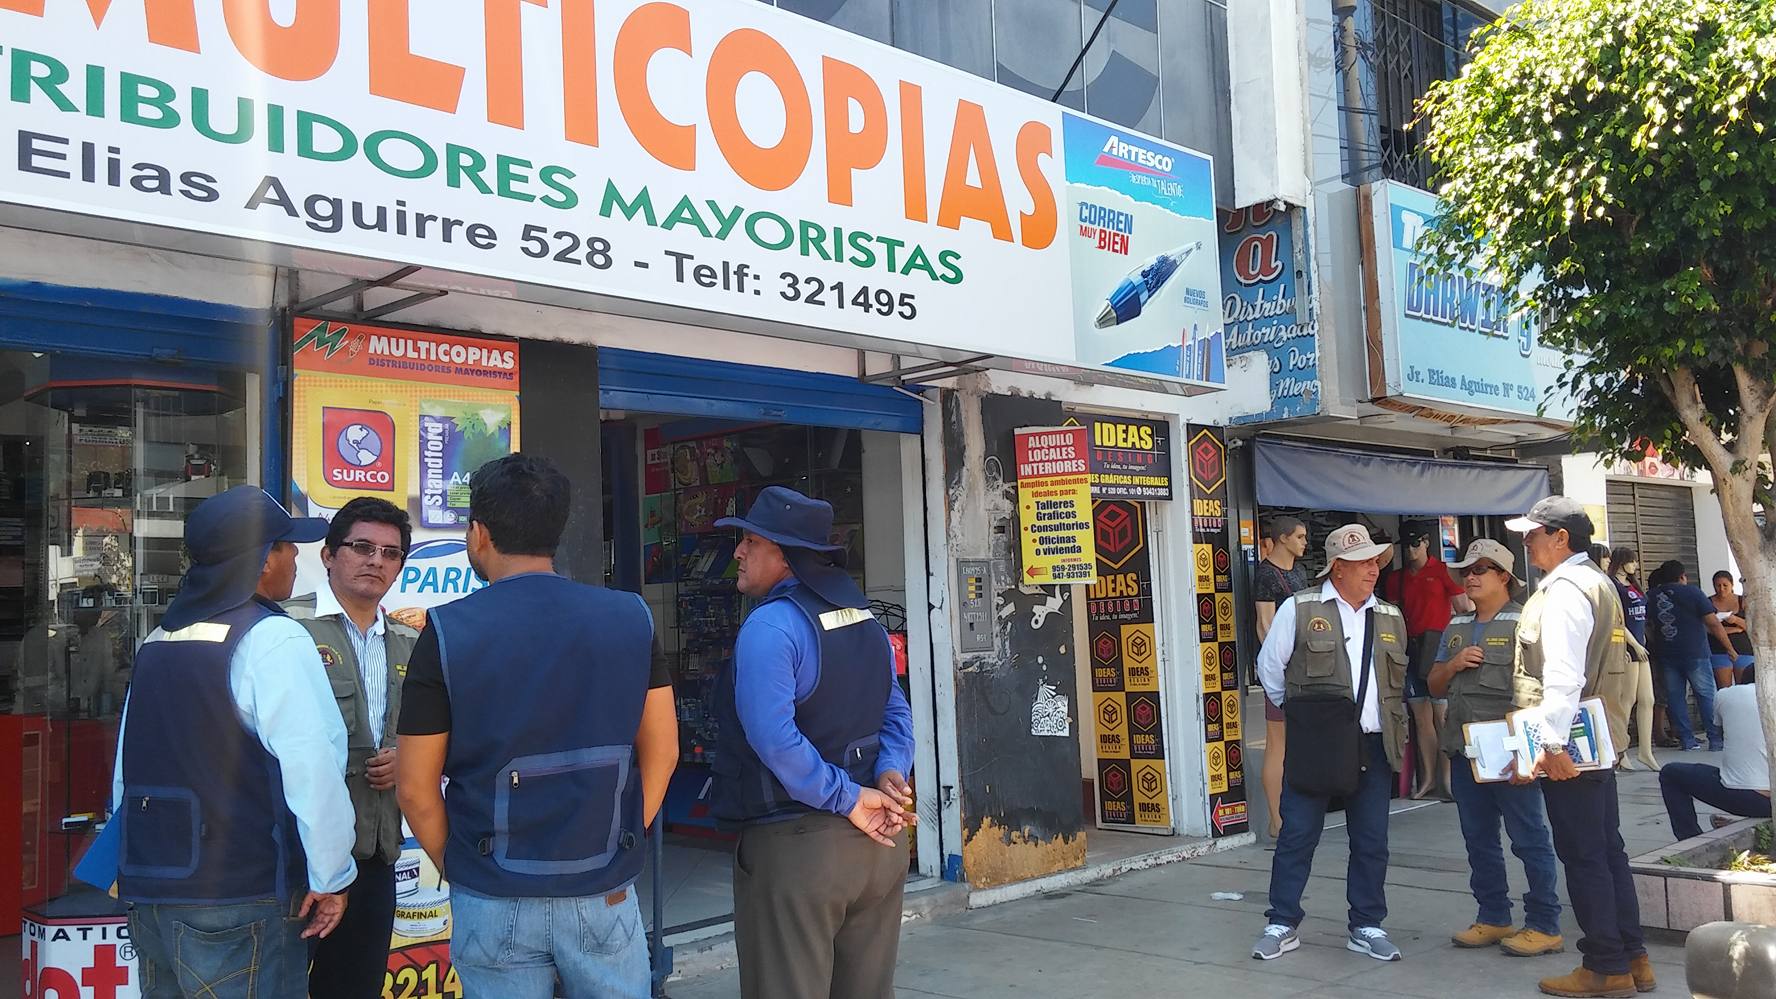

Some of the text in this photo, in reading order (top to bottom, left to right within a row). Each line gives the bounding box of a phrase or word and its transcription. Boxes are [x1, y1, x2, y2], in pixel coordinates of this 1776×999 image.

[0, 0, 1058, 250] LTICOPIAS
[1102, 135, 1172, 172] ARTESCO
[0, 46, 963, 284] RIBUIDORES MAYORISTAS
[18, 129, 219, 203] Elias
[244, 176, 498, 250] Aguirre
[520, 224, 613, 270] 528
[664, 250, 761, 296] Telf:
[779, 271, 917, 321] 321495
[1079, 202, 1133, 235] CORREN
[1079, 224, 1129, 256] MUY BIEN
[1185, 287, 1206, 299] NUEVOS
[368, 335, 514, 369] MULTICOPIAS
[368, 358, 514, 380] DISTRIBUIDORES MAYORISTAS
[1407, 365, 1424, 383] Jr.
[1460, 374, 1500, 396] Aguirre
[1517, 384, 1536, 401] 524
[1028, 433, 1073, 449] ALQUILO
[1094, 422, 1153, 450] IDEAS
[1028, 447, 1076, 462] LOCALES
[424, 422, 443, 506] Standford
[1020, 459, 1086, 476] INTERIORES
[332, 468, 390, 483] SURCO
[450, 472, 471, 485] A4
[1133, 475, 1168, 487] INTEGRALES
[1020, 477, 1088, 489] Amplios ambientes
[1060, 488, 1078, 497] para:
[1035, 499, 1075, 510] Talleres
[1193, 499, 1221, 517] IDEAS
[1036, 510, 1077, 521] Graficos
[1030, 521, 1090, 533] Consultorios
[1038, 535, 1077, 545] Oficinas
[1035, 545, 1082, 556] o vivienda
[1052, 563, 1093, 572] 959-291535
[1052, 571, 1091, 580] 947-931391
[1089, 573, 1138, 598] IDEAS
[1090, 600, 1140, 614] DESIGN
[1096, 668, 1116, 678] IDEAS
[1128, 667, 1149, 677] IDEAS
[1100, 734, 1120, 744] IDEAS
[1133, 734, 1155, 744] IDEAS
[1105, 800, 1126, 811] IDEAS
[1138, 802, 1160, 813] IDEAS
[396, 909, 438, 920] GRAFINAL
